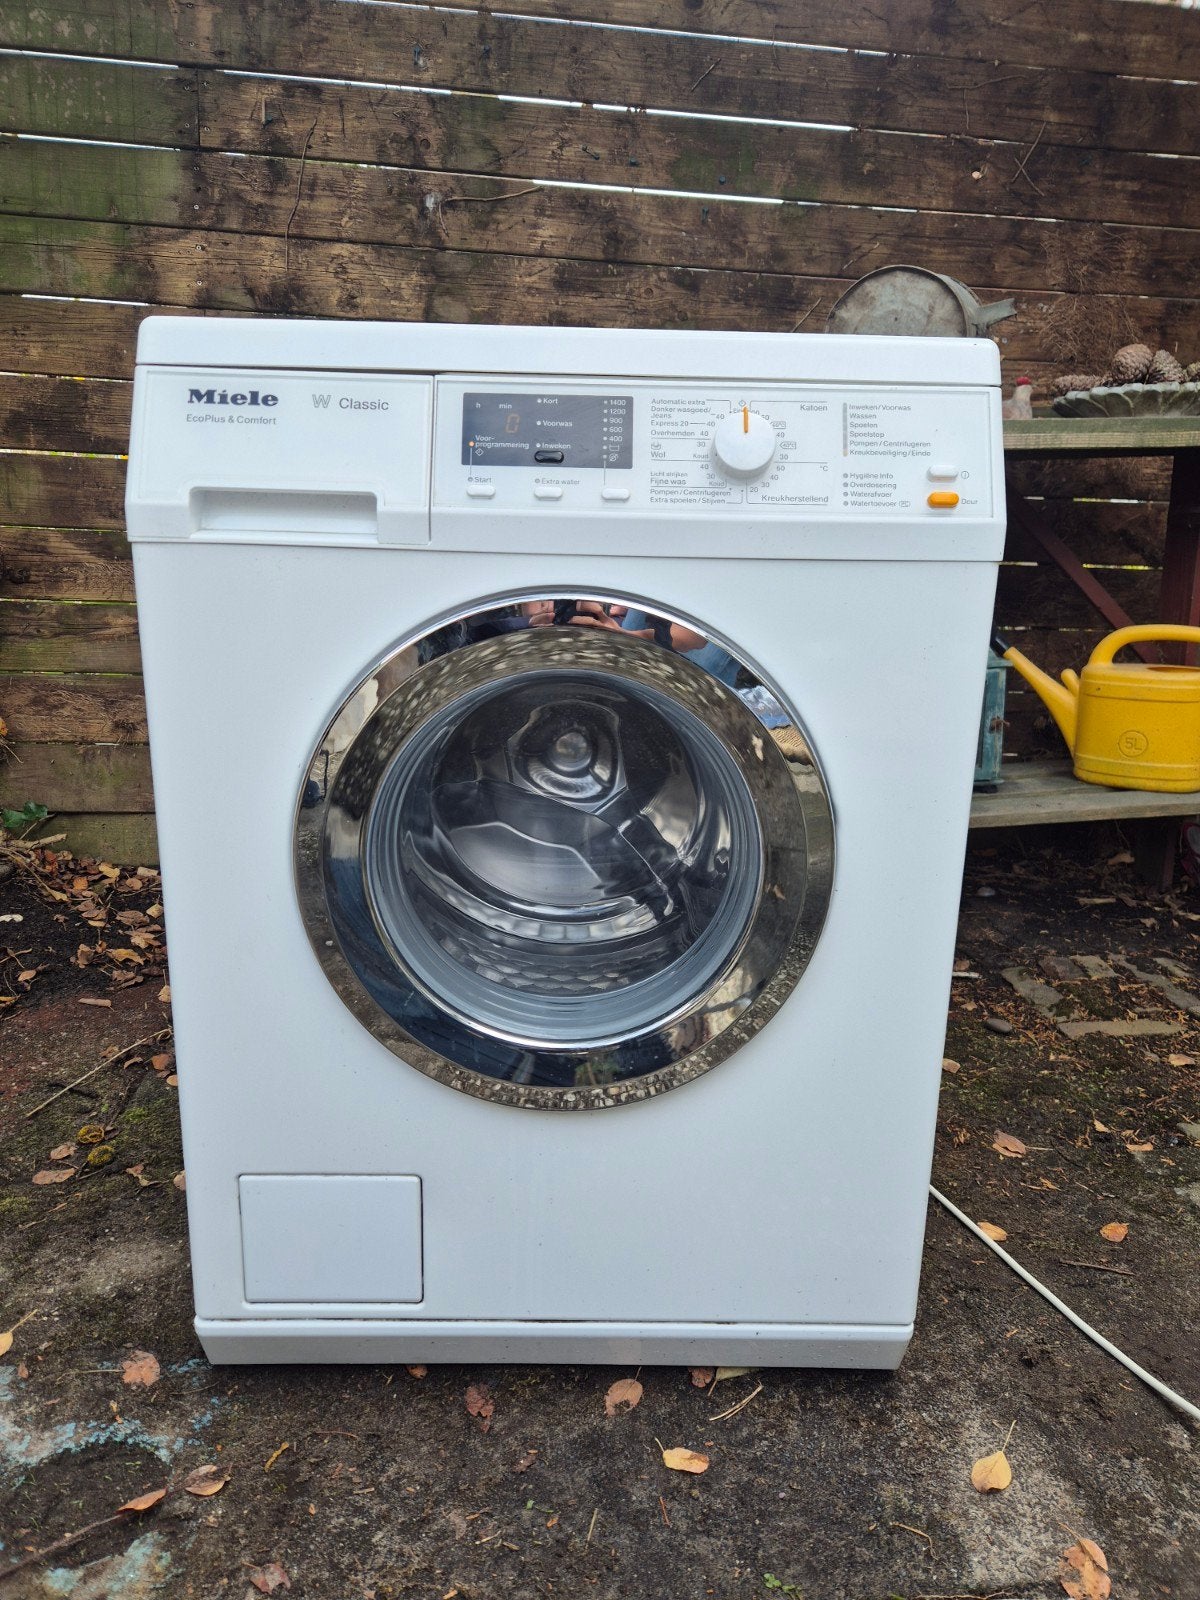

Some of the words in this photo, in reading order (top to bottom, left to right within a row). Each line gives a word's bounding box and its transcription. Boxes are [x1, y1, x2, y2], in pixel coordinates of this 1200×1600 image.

[187, 388, 279, 407] Miele
[312, 394, 331, 408] W
[338, 397, 389, 411] Classic
[677, 406, 712, 415] wasgoed/
[186, 413, 225, 424] EcoPlus
[228, 415, 234, 424] &
[237, 415, 277, 425] Comfort
[850, 421, 878, 429] Spoelen
[651, 429, 696, 437] Overhemden
[884, 440, 931, 448] Centrifugeren
[850, 482, 897, 490] Overdosering
[684, 489, 732, 497] Centrifugeren
[762, 495, 829, 503] Kreukherstellend
[1125, 737, 1142, 750] 5L
